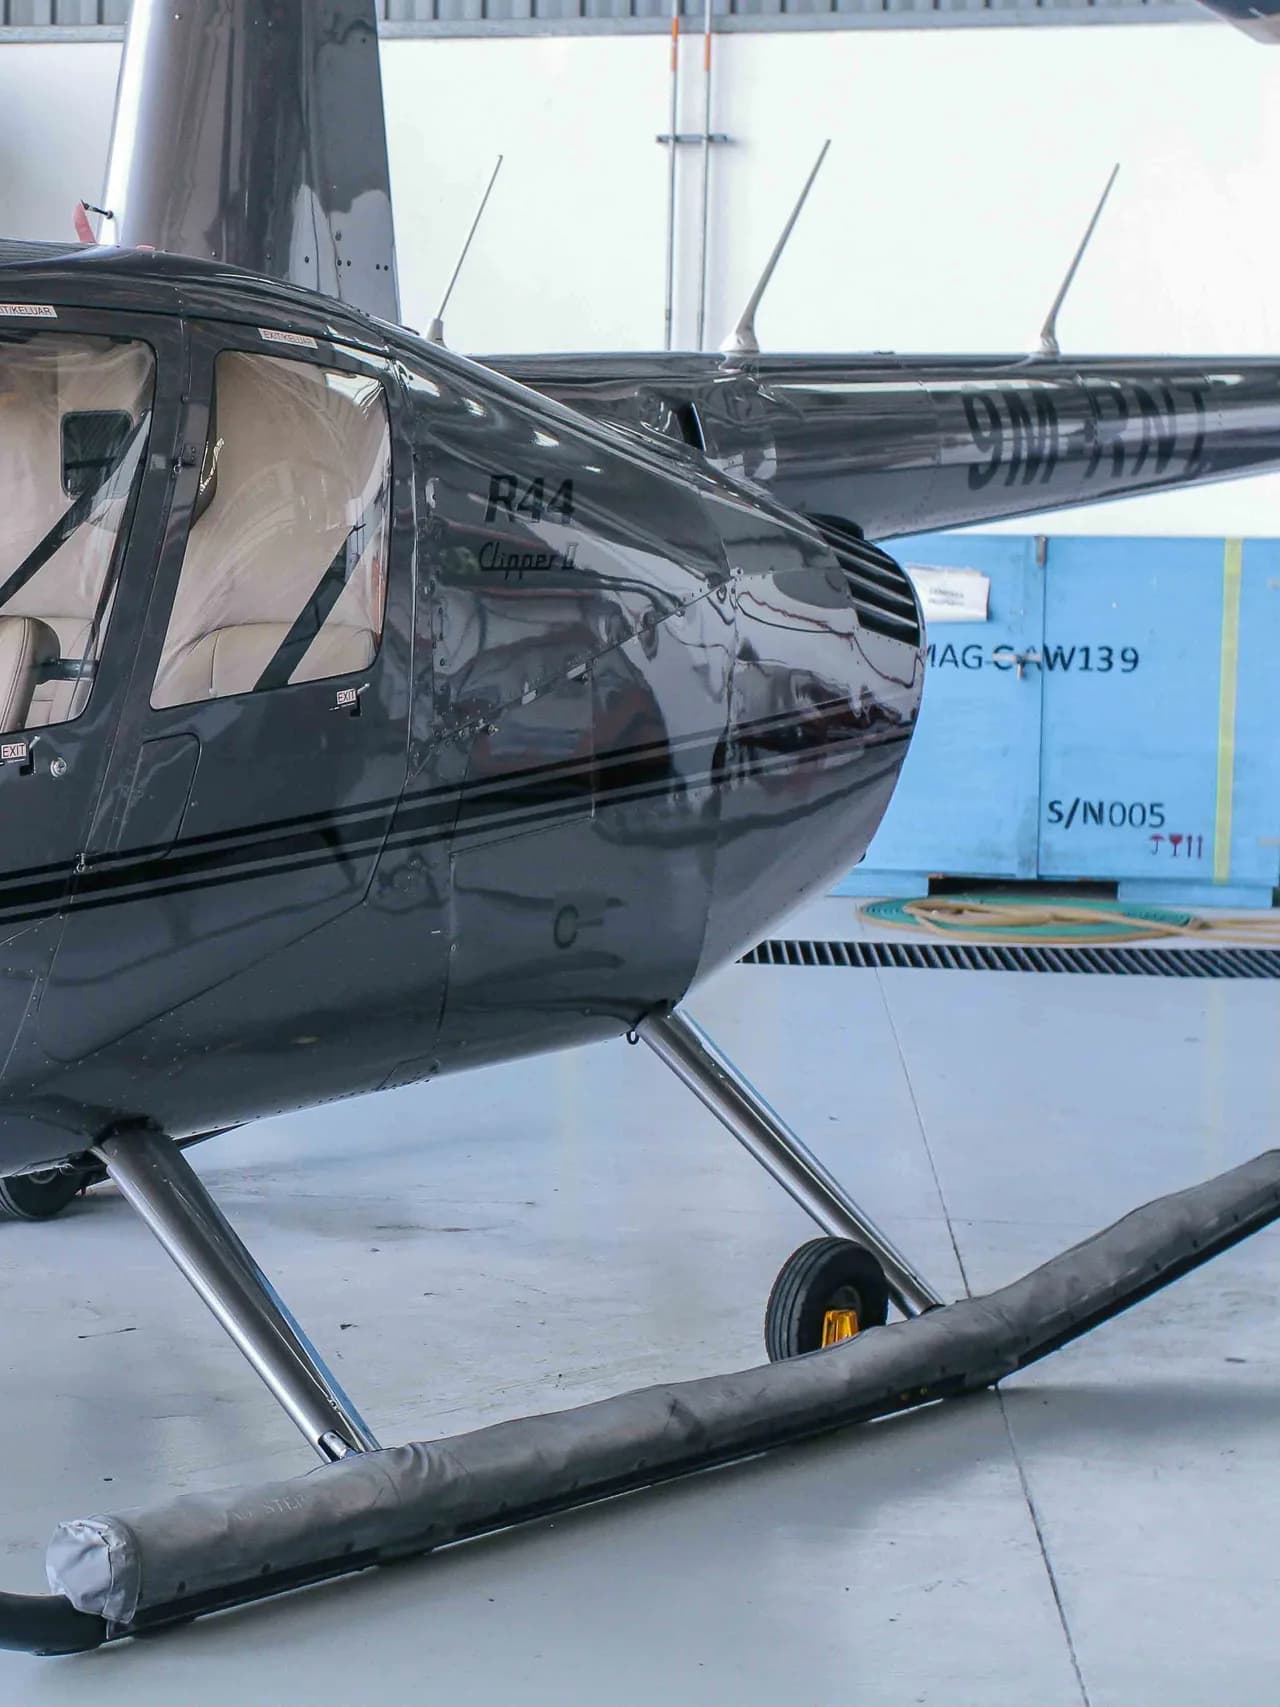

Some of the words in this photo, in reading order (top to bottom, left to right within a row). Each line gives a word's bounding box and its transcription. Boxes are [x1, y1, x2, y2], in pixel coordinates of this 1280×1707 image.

[485, 475, 575, 524] R44
[480, 541, 560, 580] Clipper
[337, 690, 355, 703] EXIT
[2, 744, 25, 758] EXIT
